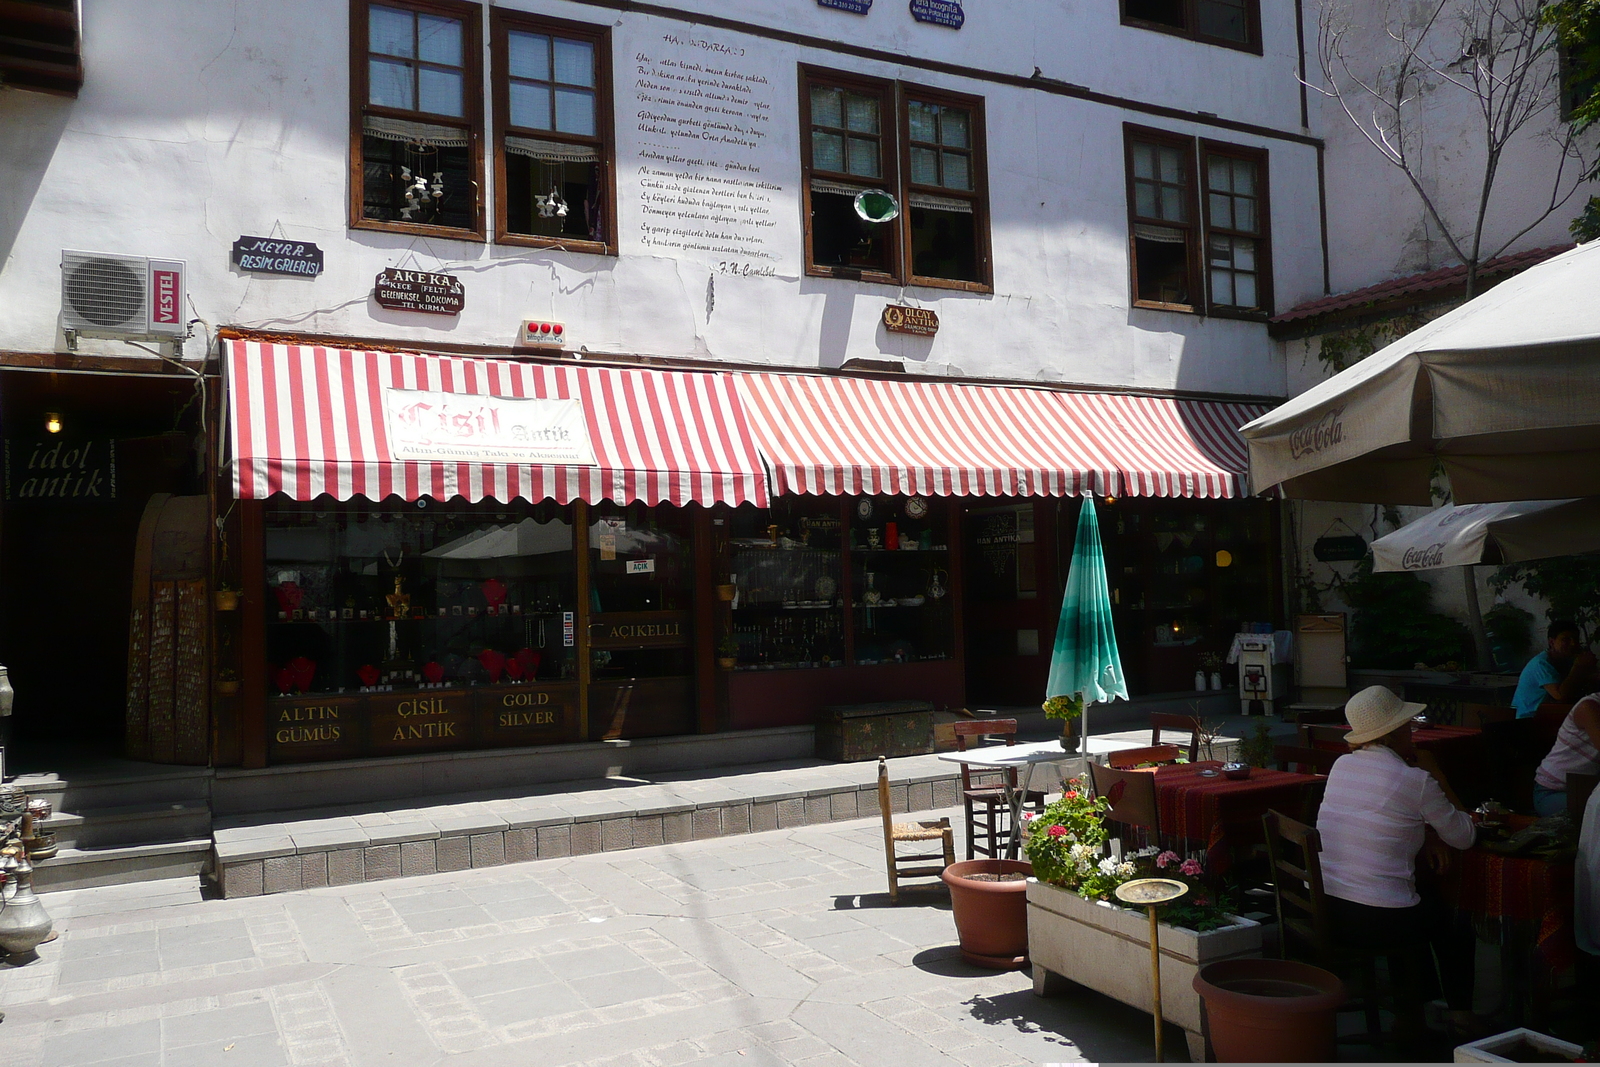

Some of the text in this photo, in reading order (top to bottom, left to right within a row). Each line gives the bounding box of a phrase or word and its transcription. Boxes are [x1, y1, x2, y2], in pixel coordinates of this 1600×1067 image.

[250, 240, 305, 257] MEYRA
[160, 272, 173, 322] VESTEL
[381, 290, 459, 306] GELENEKSEL DOKUMA
[905, 308, 932, 320] OLCAY
[1289, 403, 1348, 460] Coca-Cola
[28, 441, 93, 470] idol
[19, 468, 104, 498] antik
[1402, 540, 1449, 570] Coca-Cola
[633, 562, 648, 571] AÇIK
[609, 621, 680, 639] AÇIKELLİ
[397, 697, 449, 718] ÇİSİL
[502, 692, 549, 707] GOLD
[279, 705, 339, 721] ALTIN
[275, 724, 341, 743] GÜMÜŞ
[392, 720, 457, 741] ANTİK
